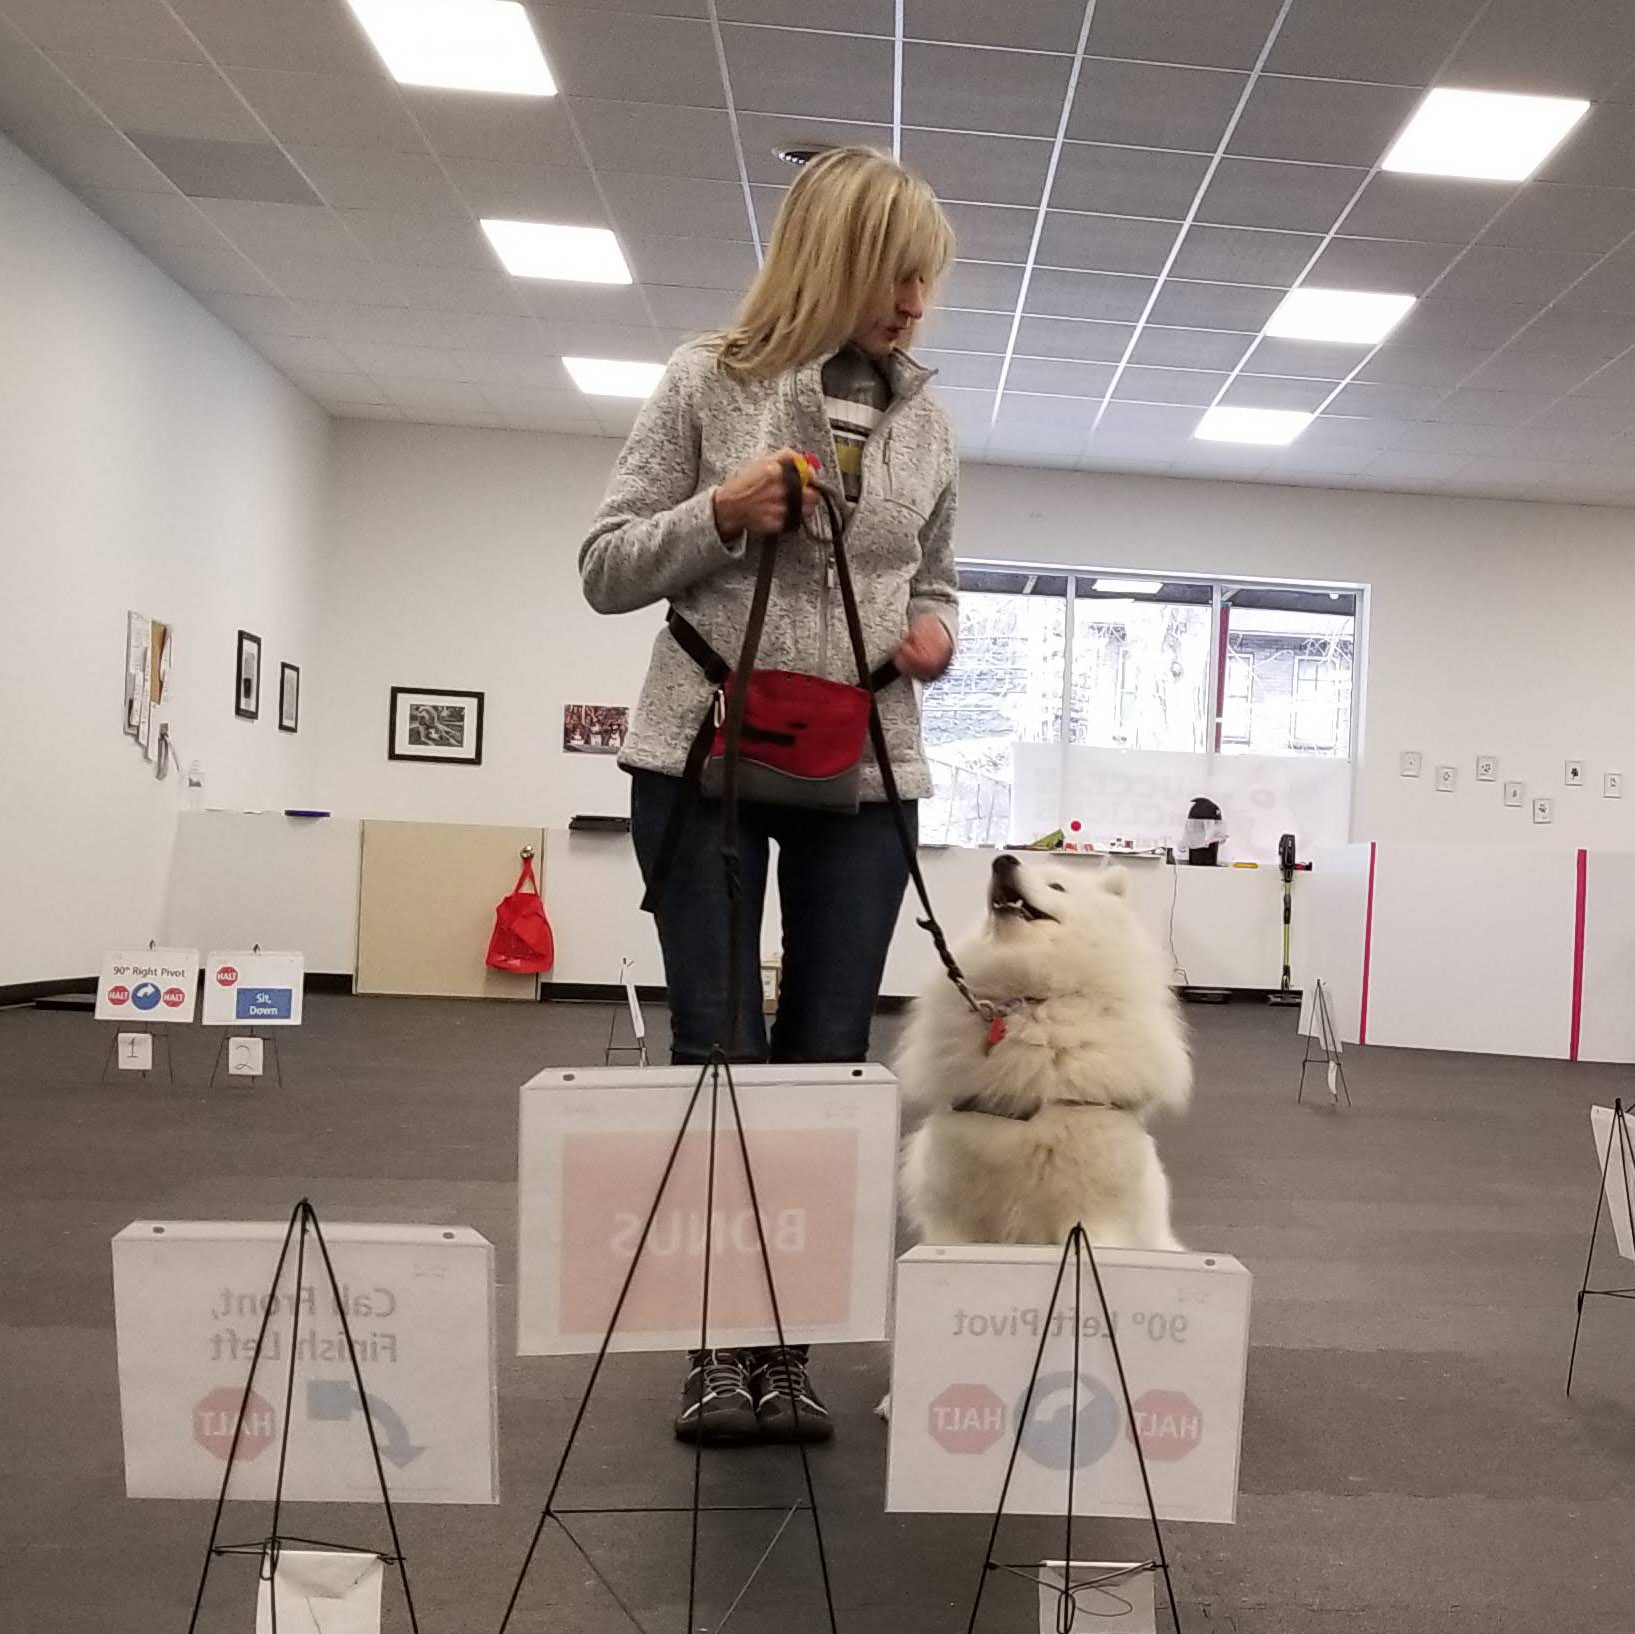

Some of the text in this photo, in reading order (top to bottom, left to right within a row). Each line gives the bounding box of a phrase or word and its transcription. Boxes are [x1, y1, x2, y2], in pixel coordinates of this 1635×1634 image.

[132, 966, 158, 978] Right
[161, 967, 186, 978] Pivot
[216, 971, 238, 981] HALT
[107, 990, 129, 1001] HALT
[163, 992, 185, 1003] HALT
[249, 1005, 279, 1016] Down
[126, 1037, 140, 1059] 1
[234, 1044, 254, 1071] 2
